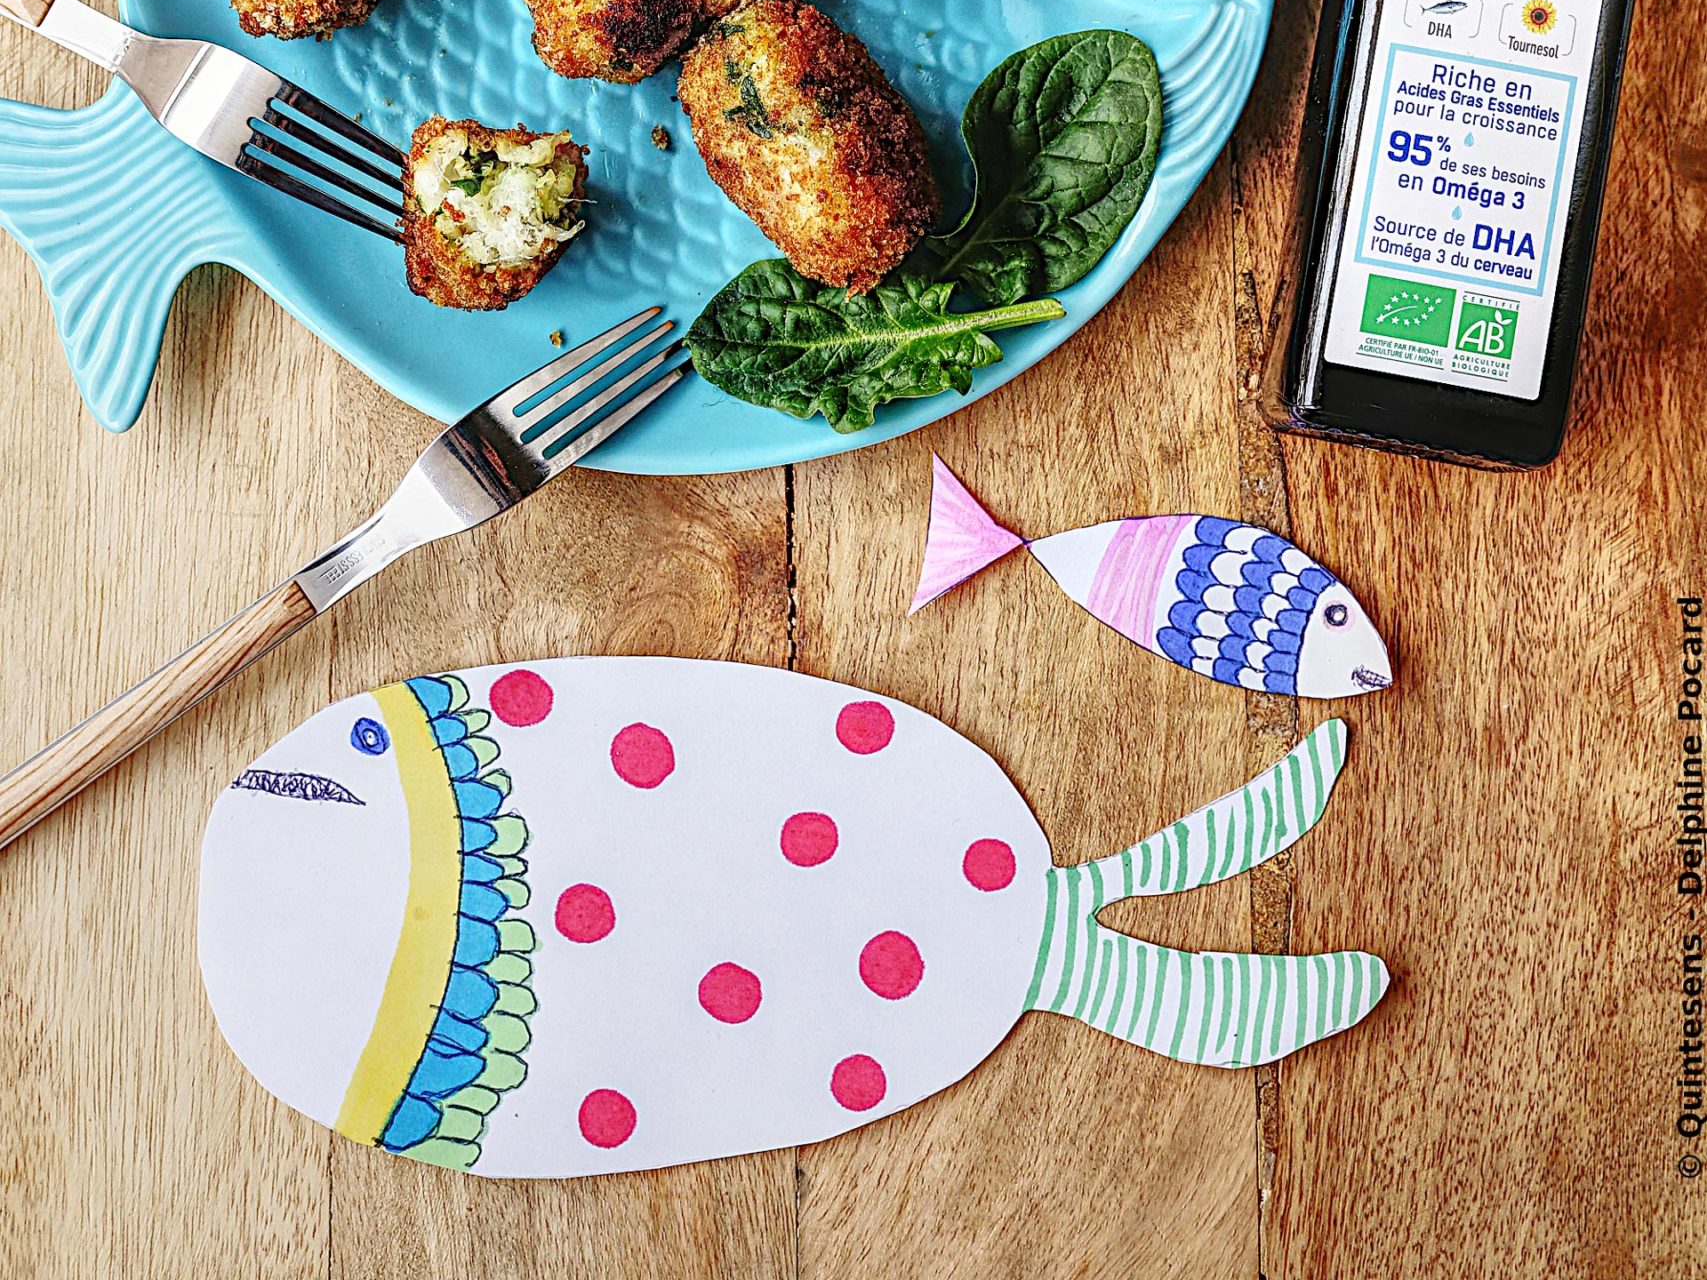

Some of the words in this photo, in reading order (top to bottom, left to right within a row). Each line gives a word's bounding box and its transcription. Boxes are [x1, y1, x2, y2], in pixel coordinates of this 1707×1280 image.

[1427, 21, 1452, 39] DHA
[1508, 35, 1559, 59] Tournesol
[1431, 64, 1496, 93] Riche
[1505, 81, 1532, 100] en
[1397, 80, 1446, 101] Acides
[1450, 91, 1483, 108] Gras
[1488, 97, 1560, 123] Essentiels
[1393, 99, 1434, 117] pour
[1440, 104, 1455, 121] la
[1462, 112, 1557, 141] croissance
[1440, 157, 1457, 172] de
[1461, 163, 1487, 178] ses
[1491, 166, 1546, 189] besoins
[1398, 173, 1424, 191] en
[1432, 176, 1506, 208] Oméga
[1511, 191, 1525, 210] 3
[1373, 215, 1437, 241] Source
[1443, 228, 1465, 246] de
[1472, 223, 1536, 260] DHA
[1370, 236, 1431, 263] l'Oméga
[1436, 249, 1446, 263] 3
[1450, 251, 1469, 268] du
[1474, 258, 1533, 280] cerveau
[1393, 342, 1407, 351] PAR
[1458, 320, 1505, 355] AB
[1358, 344, 1403, 359] AGRICULTURE
[1404, 351, 1414, 360] UE
[1418, 354, 1434, 364] NON
[1434, 357, 1444, 366] UE
[1451, 362, 1509, 378] BIOLOGIQUE
[1453, 353, 1511, 370] AGRICULTURE
